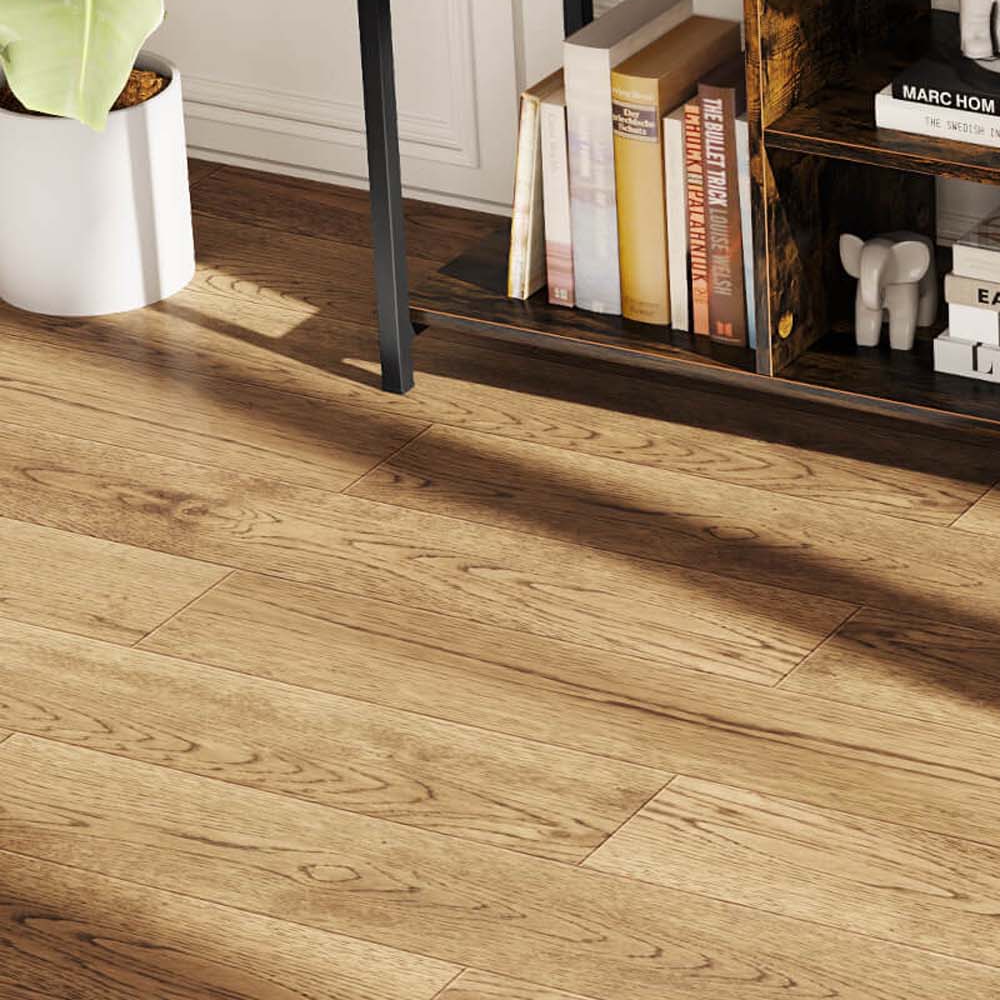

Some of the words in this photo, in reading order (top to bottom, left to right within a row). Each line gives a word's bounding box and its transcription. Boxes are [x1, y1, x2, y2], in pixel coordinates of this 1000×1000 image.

[703, 98, 723, 120] THE
[902, 85, 952, 106] MARC
[955, 92, 996, 113] HOM
[704, 122, 727, 167] BULLET
[925, 115, 941, 129] THE
[946, 119, 985, 137] SWEDISH
[707, 169, 729, 208] TRICK
[709, 208, 730, 251] LOUISE
[712, 254, 733, 296] WELSH
